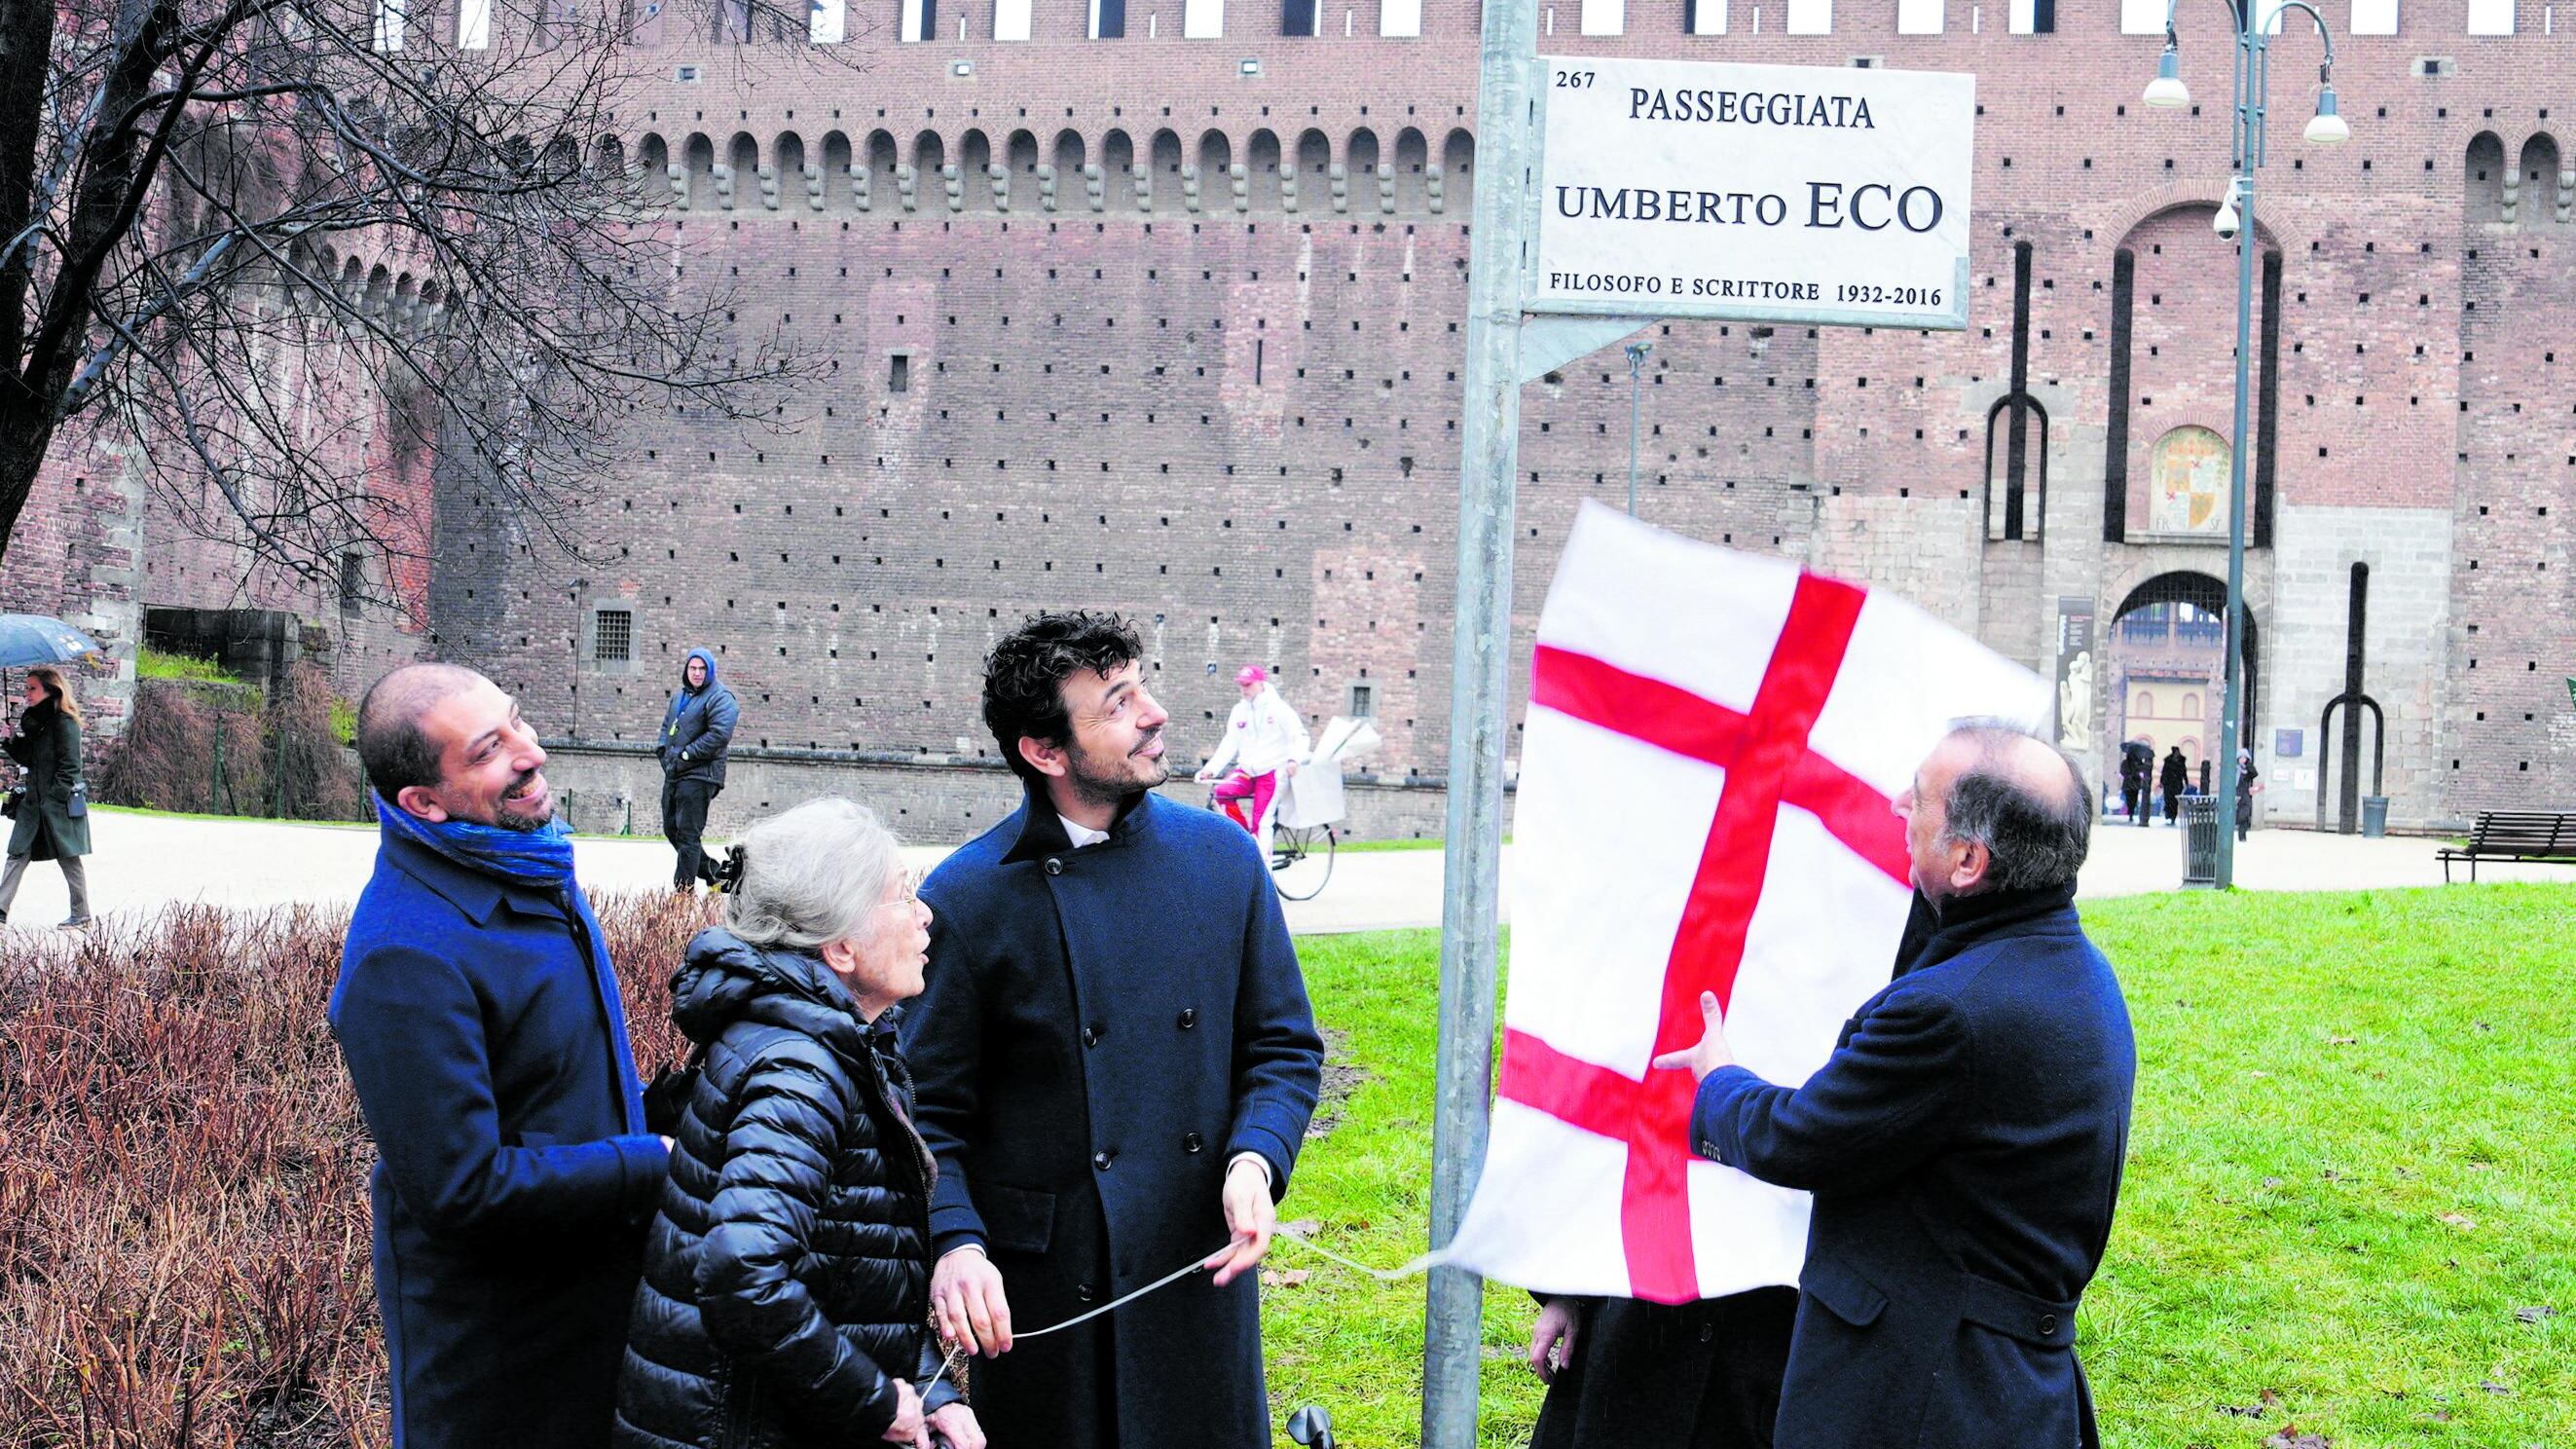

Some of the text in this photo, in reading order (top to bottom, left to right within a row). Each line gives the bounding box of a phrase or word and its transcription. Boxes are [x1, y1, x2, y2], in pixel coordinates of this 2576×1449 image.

[1556, 71, 1596, 89] 267
[1629, 88, 1875, 129] PASSEGGIATA
[1556, 181, 1943, 234] UMBERTO ECO
[1550, 273, 1941, 306] FILOSOFO E SCRITTORE 1932-2016
